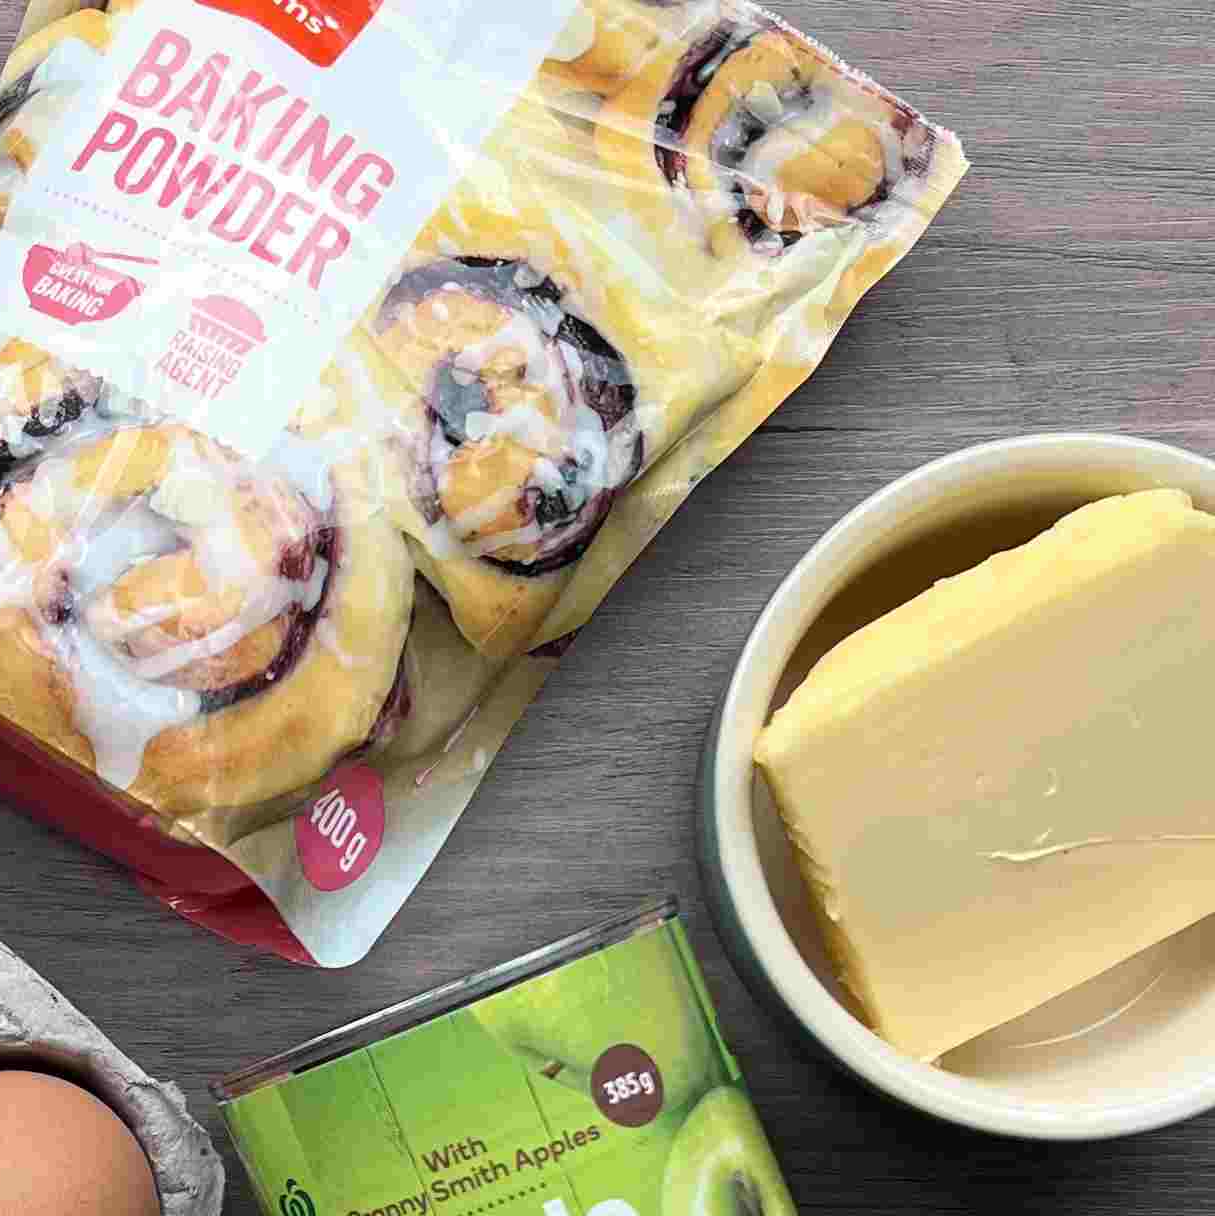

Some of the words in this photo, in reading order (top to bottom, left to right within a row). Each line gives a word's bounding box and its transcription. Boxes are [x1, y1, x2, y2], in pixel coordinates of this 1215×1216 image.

[117, 28, 397, 220] BAKING
[71, 110, 352, 290] POWDER
[32, 276, 105, 317] BAKING
[156, 352, 225, 400] AGENT
[167, 330, 243, 386] RAISING
[602, 1071, 654, 1104] 385g
[422, 1136, 488, 1173] With
[431, 1159, 510, 1203] Smith
[514, 1123, 602, 1172] Apples
